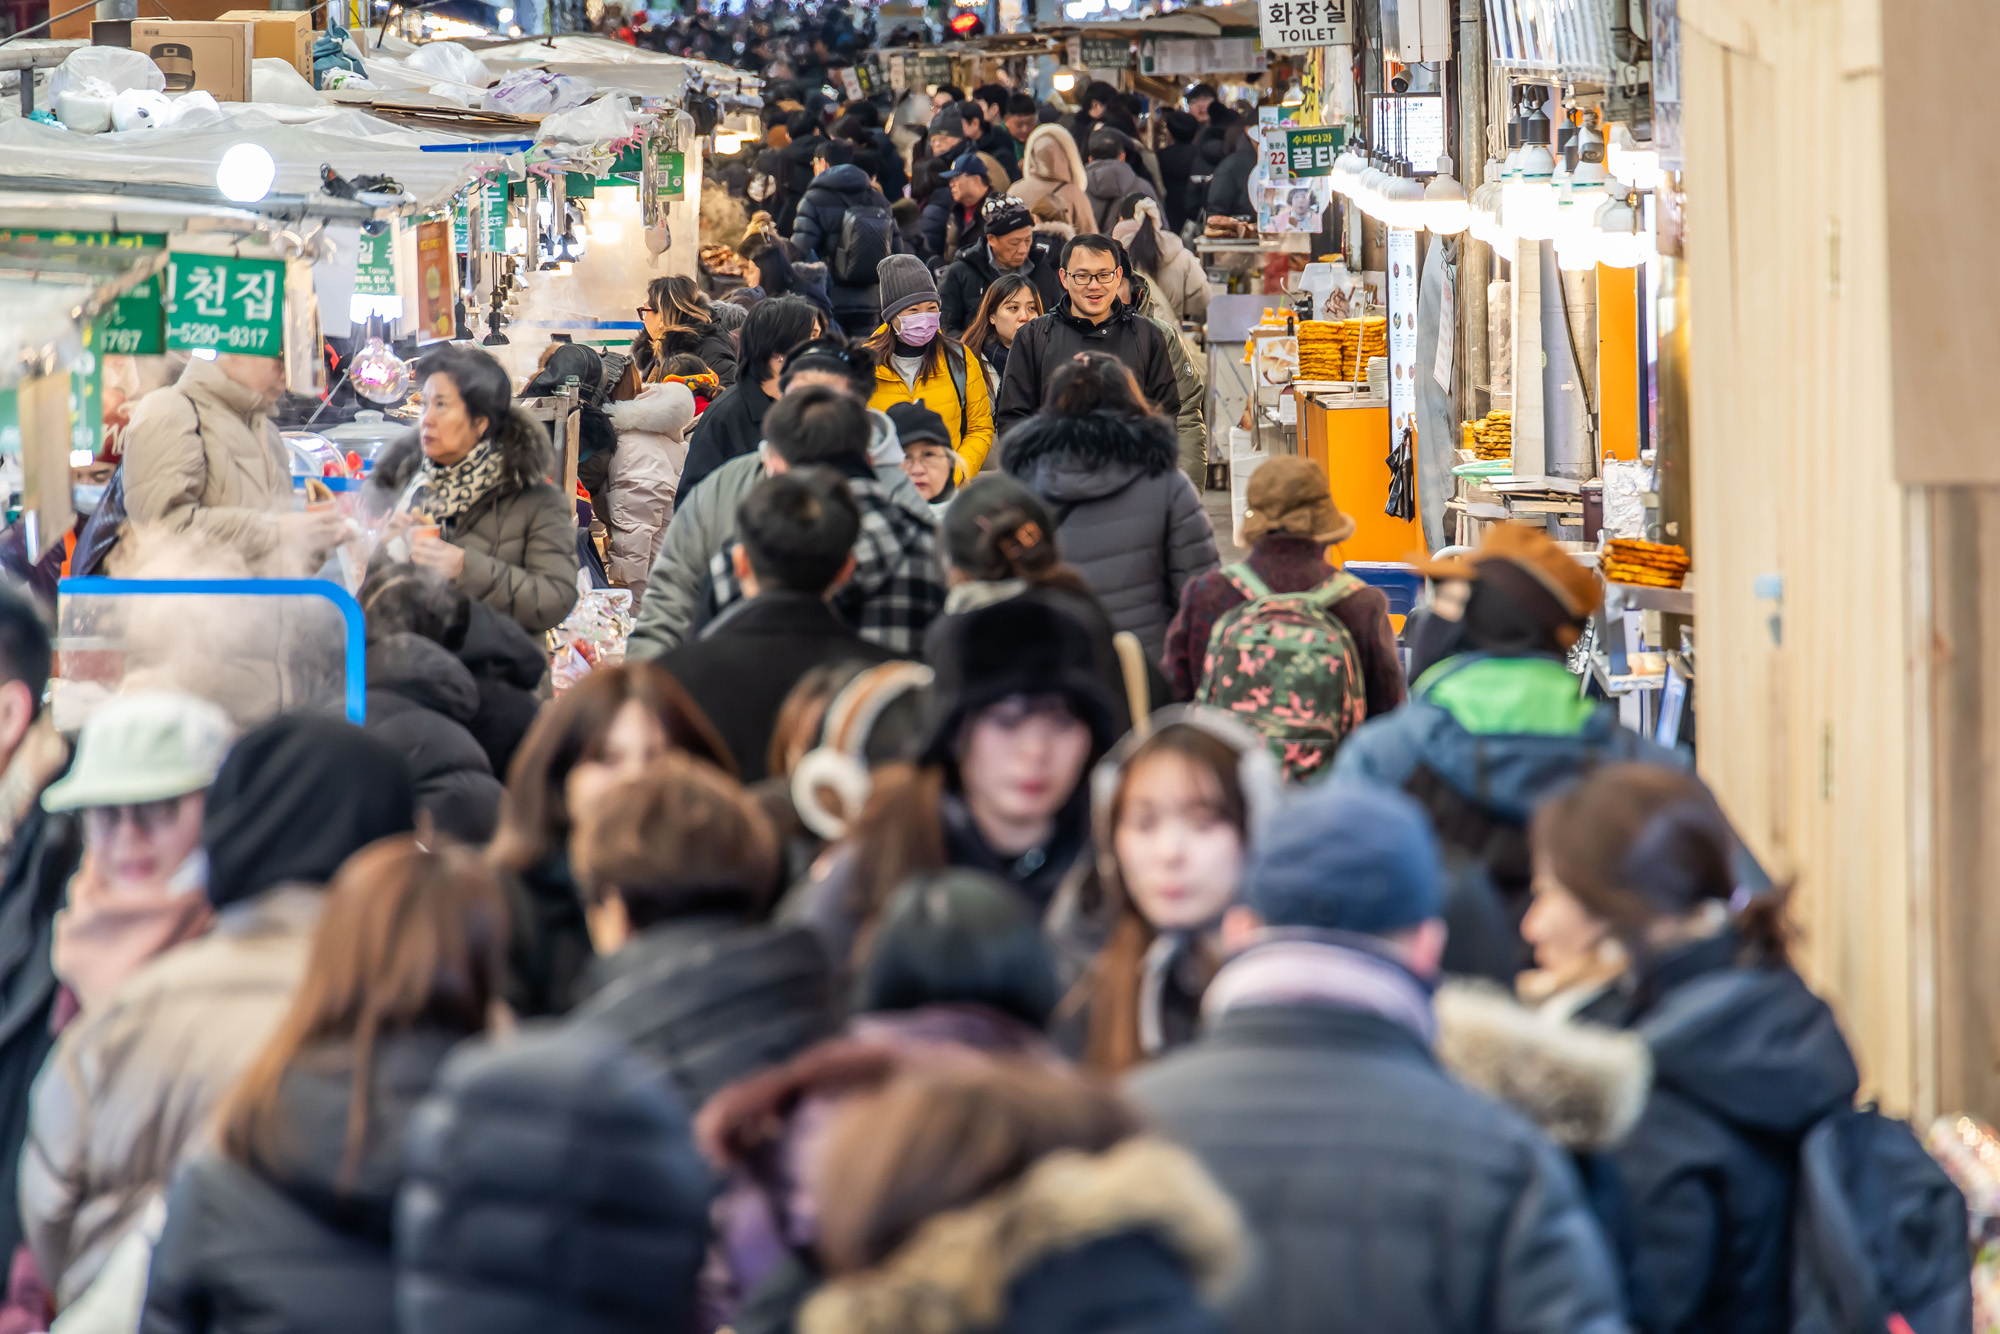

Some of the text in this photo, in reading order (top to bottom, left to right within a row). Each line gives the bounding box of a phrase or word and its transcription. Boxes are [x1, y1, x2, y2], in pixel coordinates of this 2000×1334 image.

[1268, 0, 1347, 26] 화장실
[1278, 27, 1337, 43] TOILET
[1292, 133, 1333, 146] 수제다과
[1270, 151, 1287, 165] 22
